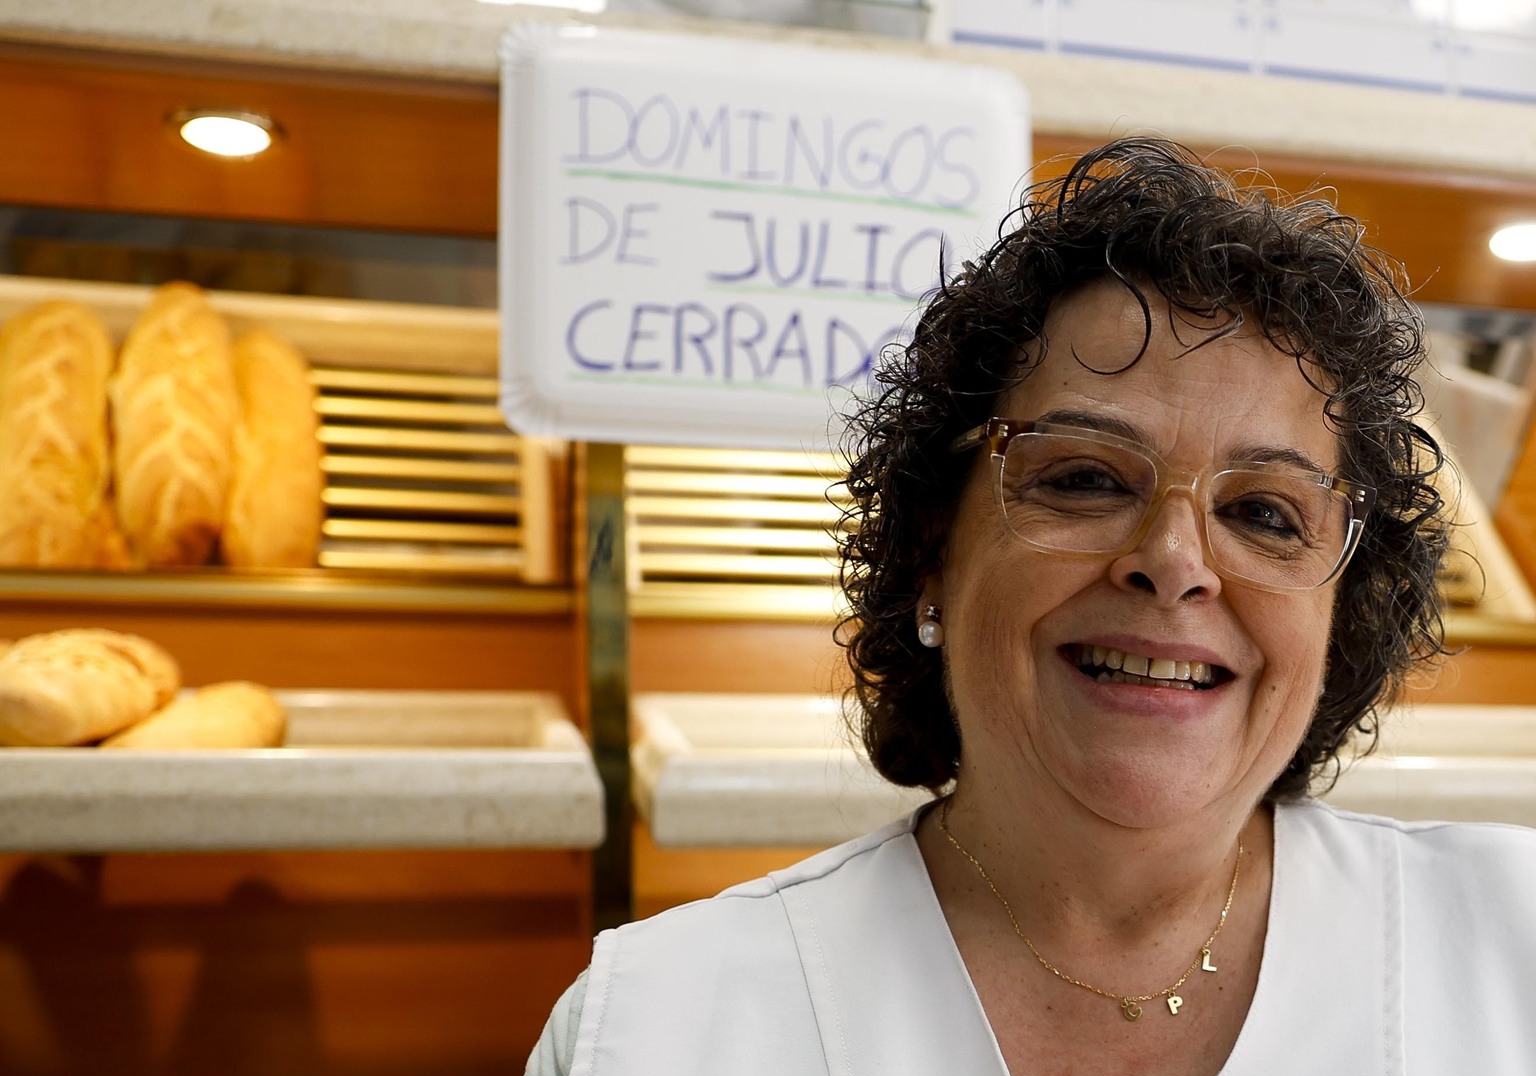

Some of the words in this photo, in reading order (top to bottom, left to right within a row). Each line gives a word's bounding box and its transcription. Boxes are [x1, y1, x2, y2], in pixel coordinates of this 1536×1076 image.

[561, 86, 981, 209] DOMINGOS
[559, 197, 661, 268] DE
[706, 209, 954, 300] JULIO
